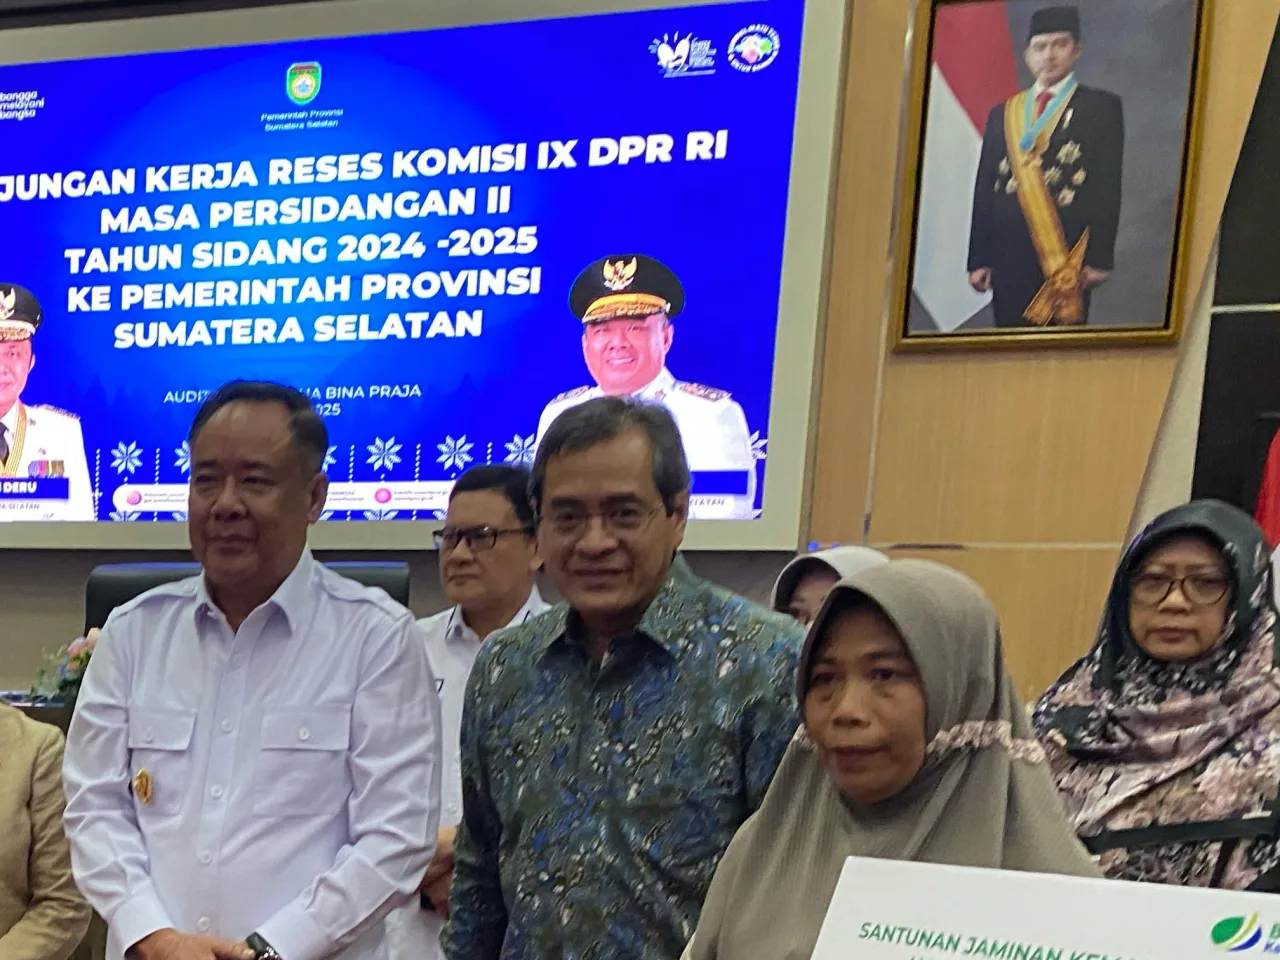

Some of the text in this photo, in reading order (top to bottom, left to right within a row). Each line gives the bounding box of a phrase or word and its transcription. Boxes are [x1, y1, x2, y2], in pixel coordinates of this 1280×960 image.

[0, 90, 38, 104] bangga
[0, 97, 45, 112] melayani
[0, 108, 36, 121] bangsa
[260, 110, 308, 122] Pemerintah
[145, 160, 259, 193] KERJA
[268, 152, 383, 186] RESES
[392, 142, 527, 179] KOMISI
[537, 139, 579, 170] IX
[588, 133, 674, 167] DPR
[685, 129, 728, 162] RI
[100, 185, 511, 234] MASA PERSIDANGAN II
[64, 243, 182, 274] TAHUN
[192, 236, 328, 269] SIDANG
[337, 231, 426, 261] 2024
[67, 266, 541, 312] KE PEMERINTAH PROVINSI
[114, 309, 483, 349] SUMATERA SELATAN
[326, 386, 365, 400] BINA
[370, 384, 422, 399] PRAJA
[4, 480, 38, 494] DERU
[858, 921, 961, 954] SANTUNAN
